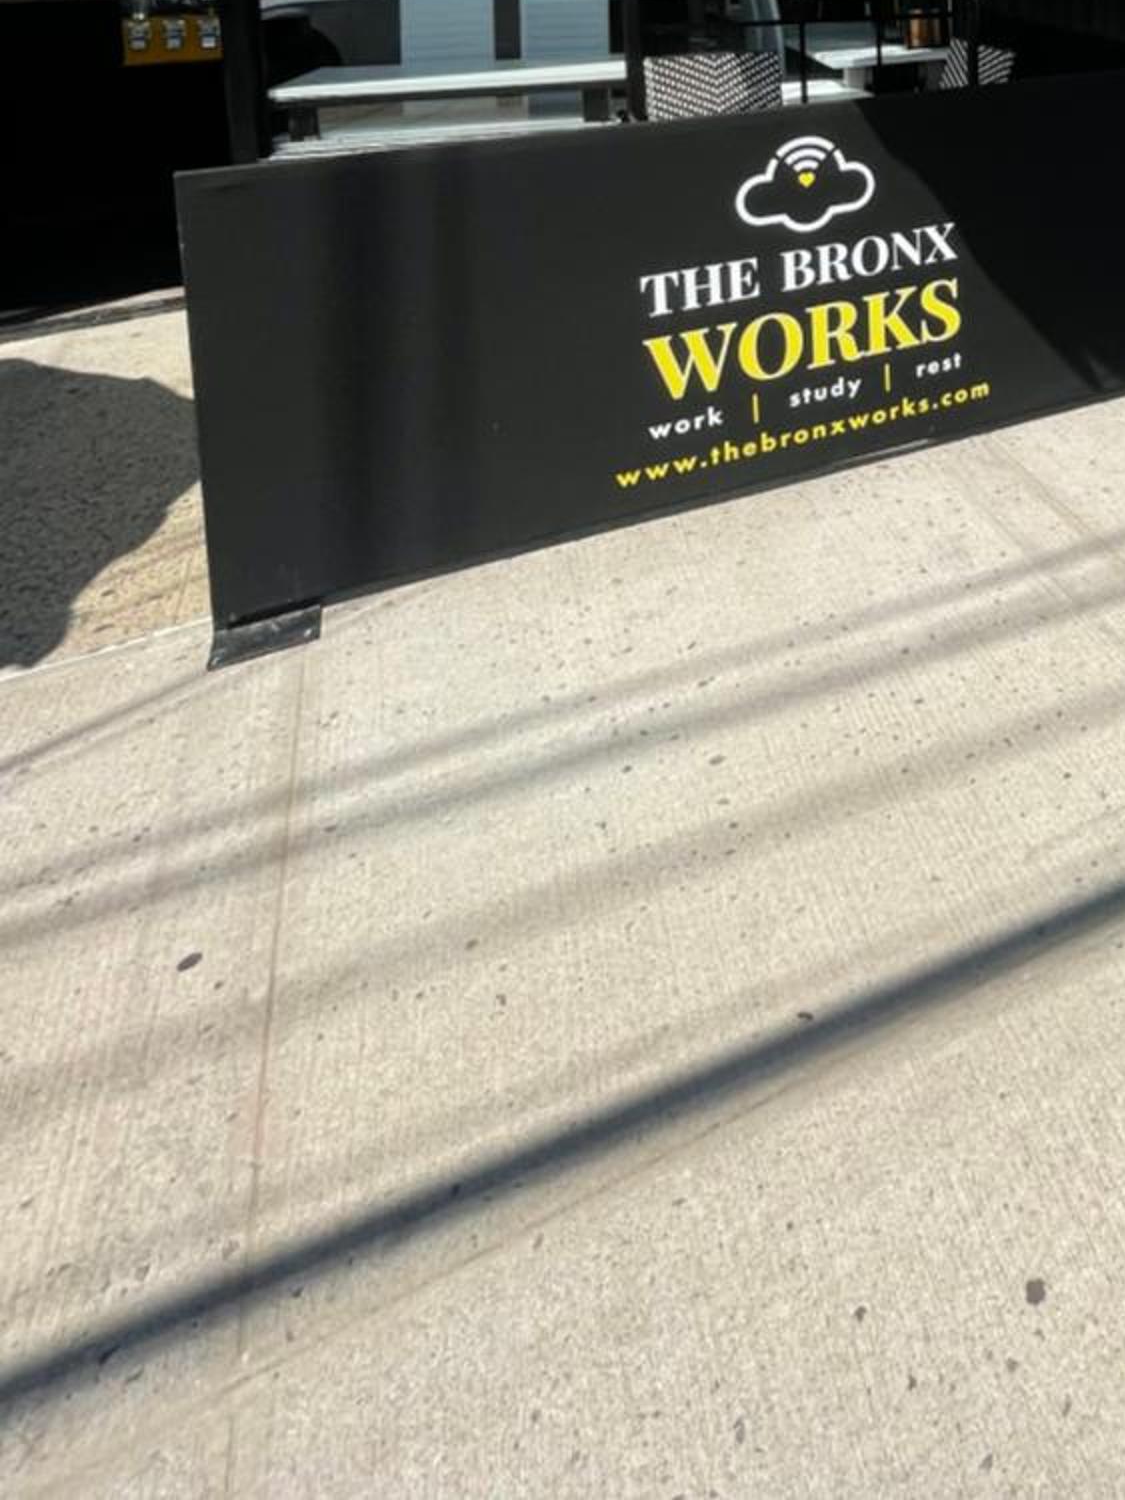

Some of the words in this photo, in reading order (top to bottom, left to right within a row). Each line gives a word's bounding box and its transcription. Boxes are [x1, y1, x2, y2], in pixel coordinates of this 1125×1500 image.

[640, 257, 761, 318] THE
[780, 222, 959, 293] BRONX
[643, 277, 963, 401] WORKS
[615, 381, 992, 488] www.thebronxworks.com
[648, 405, 724, 441] work
[788, 375, 863, 408] study
[916, 352, 963, 379] rest
